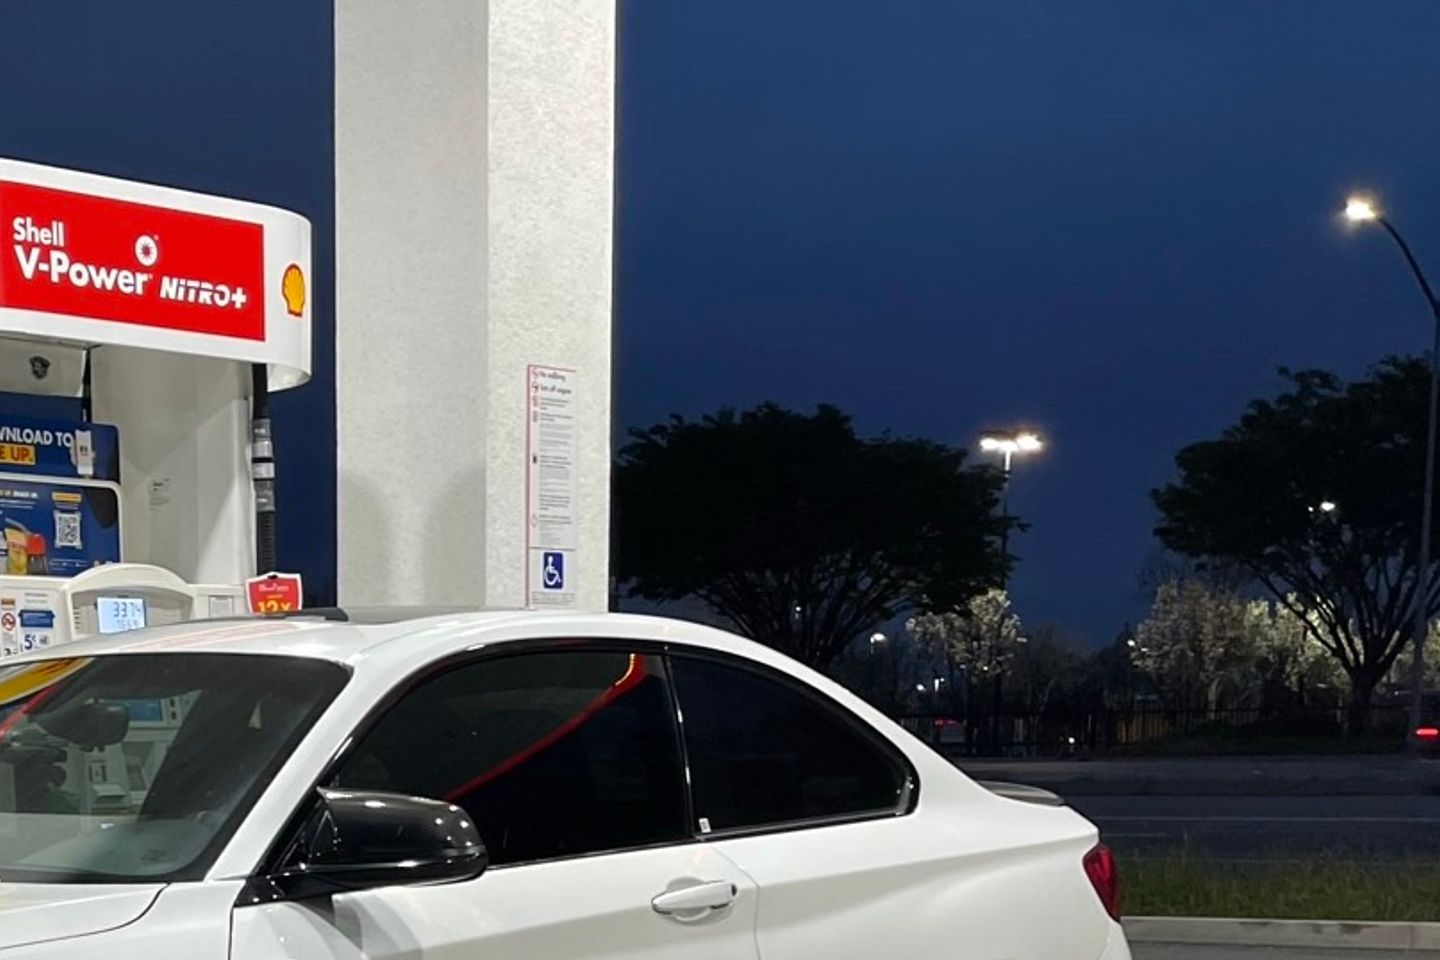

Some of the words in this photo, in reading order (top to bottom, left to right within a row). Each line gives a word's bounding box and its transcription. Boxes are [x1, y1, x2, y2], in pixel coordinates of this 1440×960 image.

[13, 217, 65, 247] Shell
[14, 245, 149, 296] V-Power
[55, 431, 74, 448] TO
